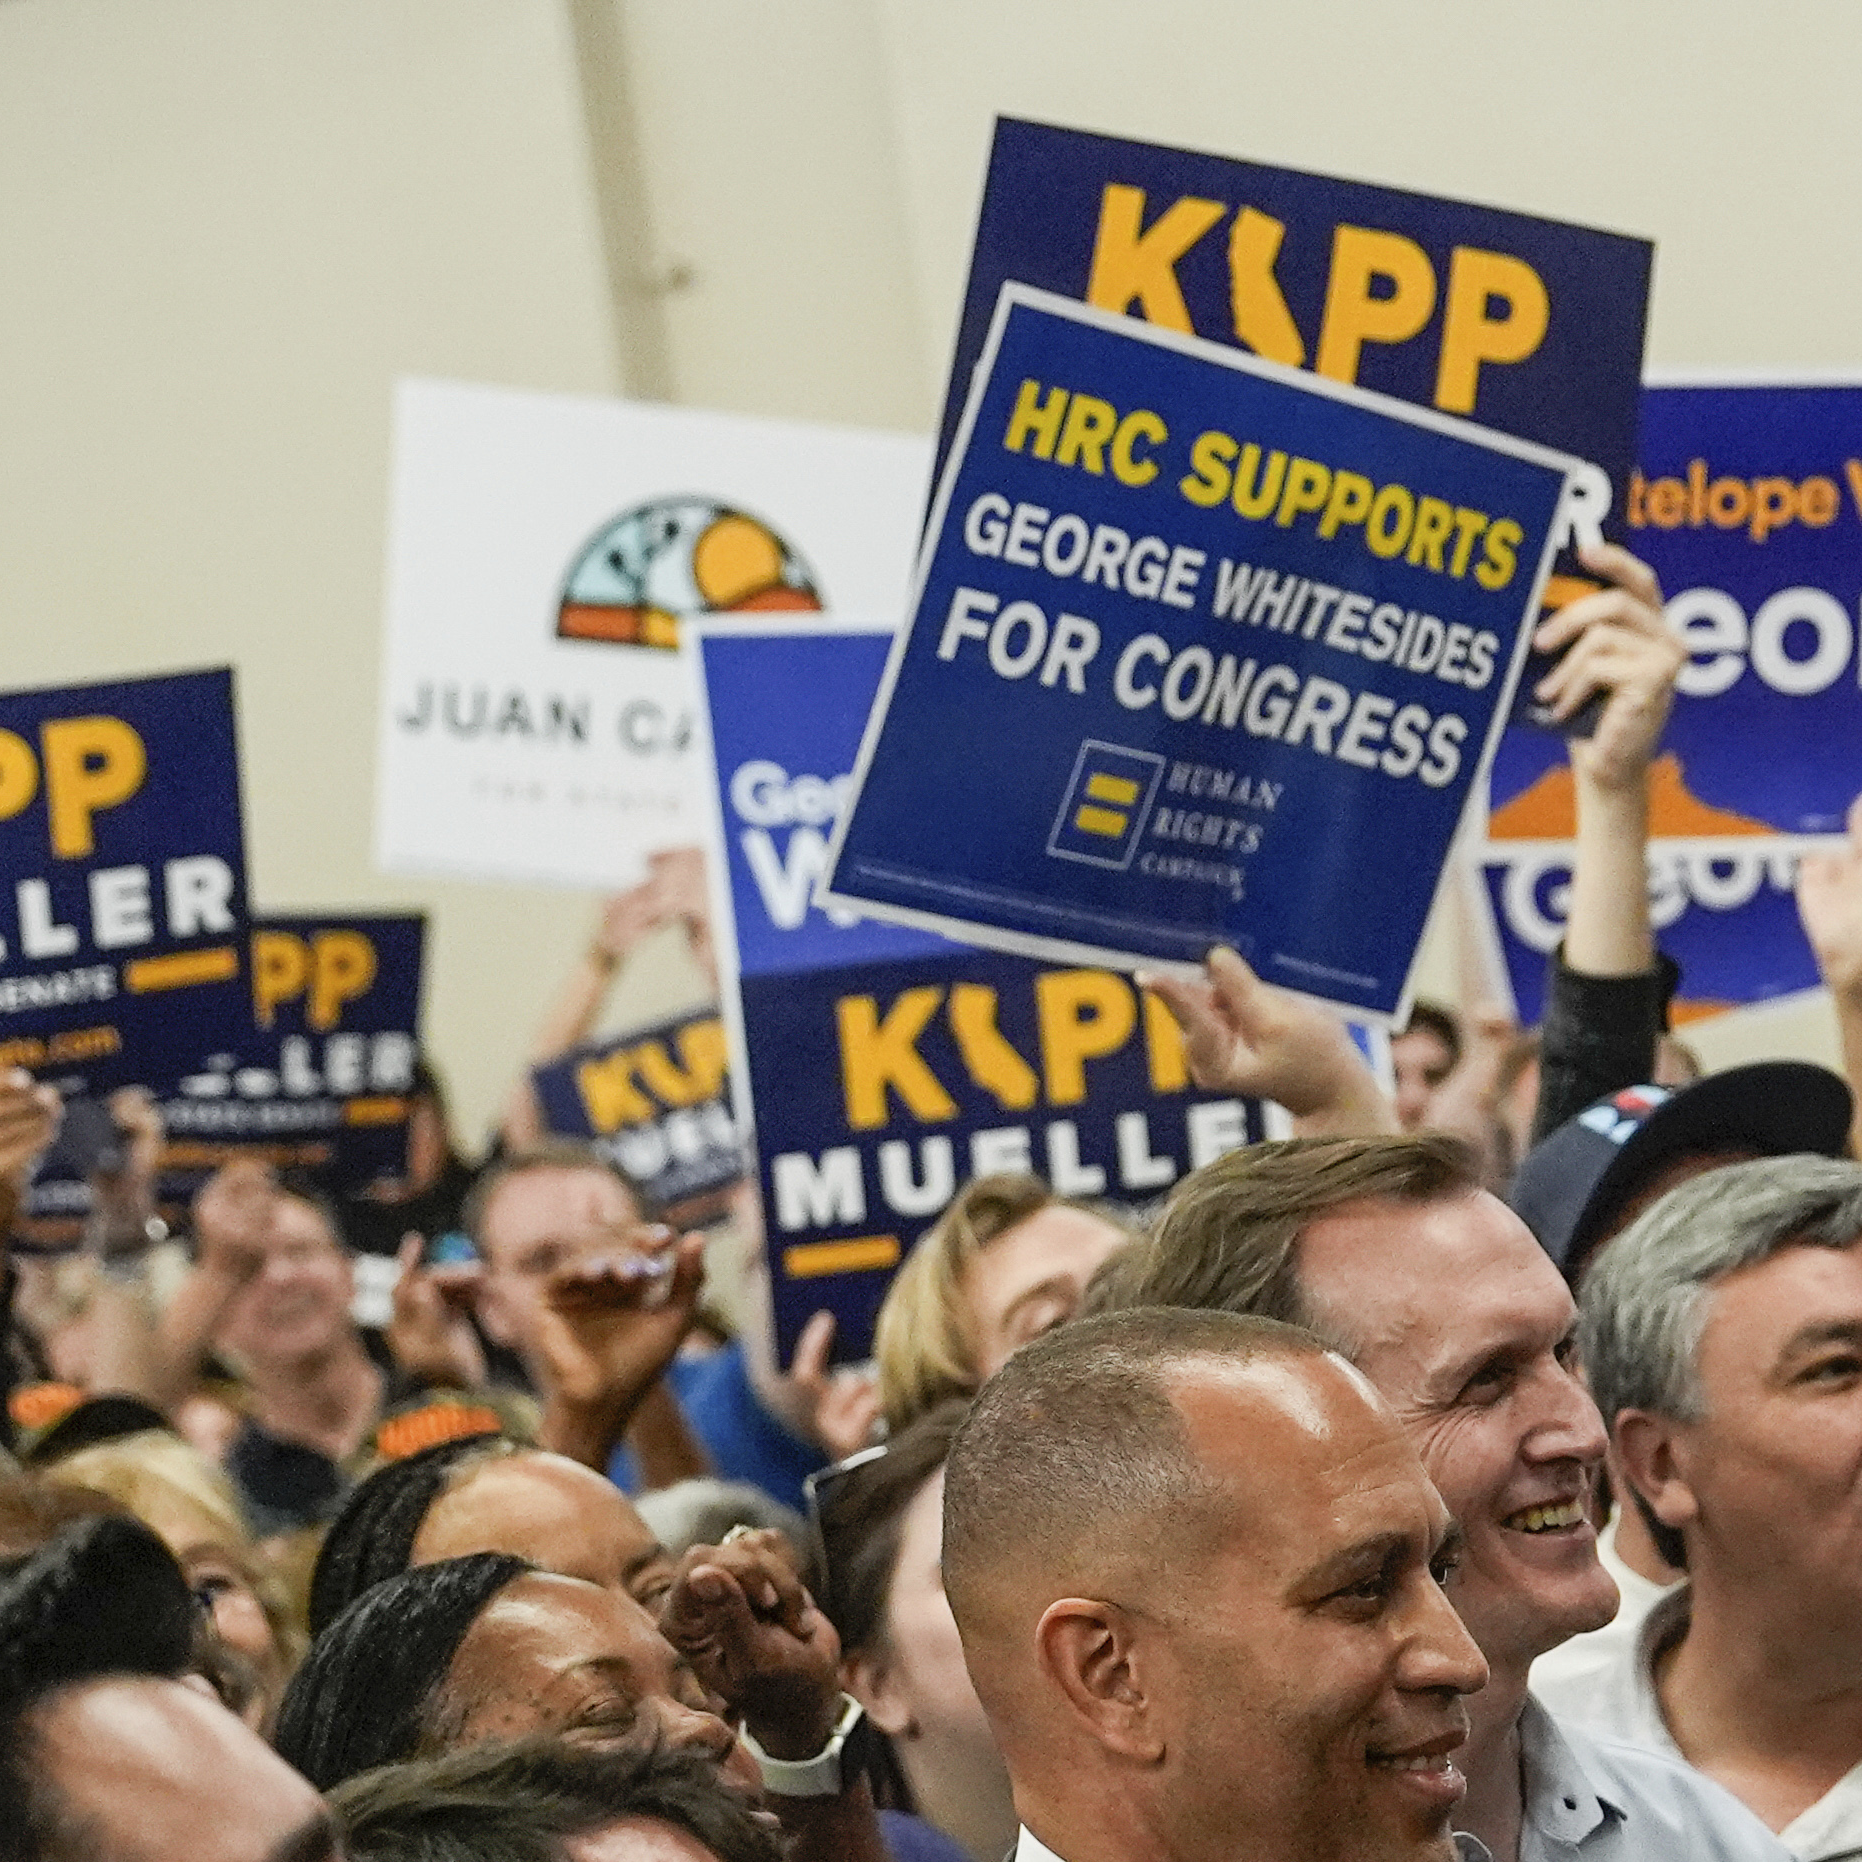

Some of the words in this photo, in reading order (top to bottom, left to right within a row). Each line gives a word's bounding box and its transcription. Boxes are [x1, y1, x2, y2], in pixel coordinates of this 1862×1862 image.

[1003, 380, 1169, 488] HRC
[1180, 430, 1526, 590] SUPPORTS
[937, 587, 1101, 695] FOR
[1113, 633, 1469, 790] CONGRESS
[964, 492, 1208, 610] GEORGE
[1213, 557, 1501, 694] WHITESIDES
[395, 682, 591, 745] JUAN
